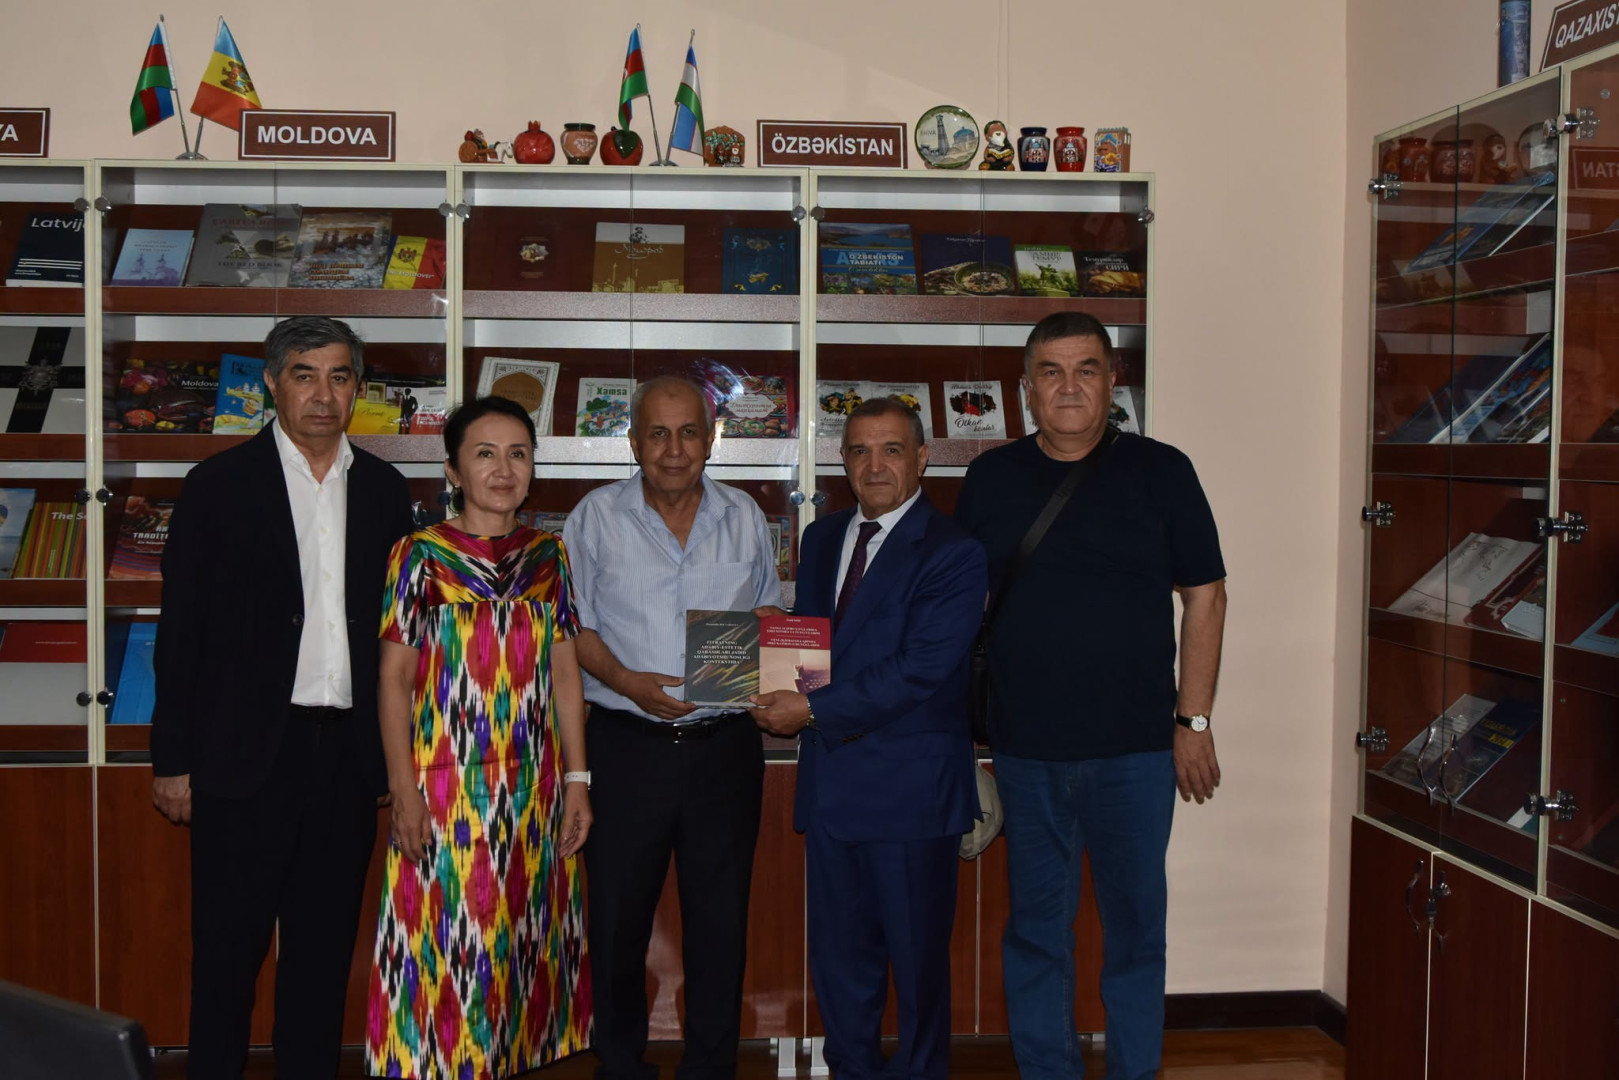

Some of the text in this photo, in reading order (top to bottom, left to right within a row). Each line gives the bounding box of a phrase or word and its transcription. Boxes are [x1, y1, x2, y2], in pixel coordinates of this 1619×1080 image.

[1555, 2, 1619, 49] QAZAXIS
[0, 124, 18, 142] A
[257, 125, 377, 146] MOLDOVA
[772, 132, 894, 157] ÖZBƏKİSTAN
[31, 217, 85, 233] Latvij
[597, 387, 627, 397] Xamsa
[51, 512, 73, 520] The
